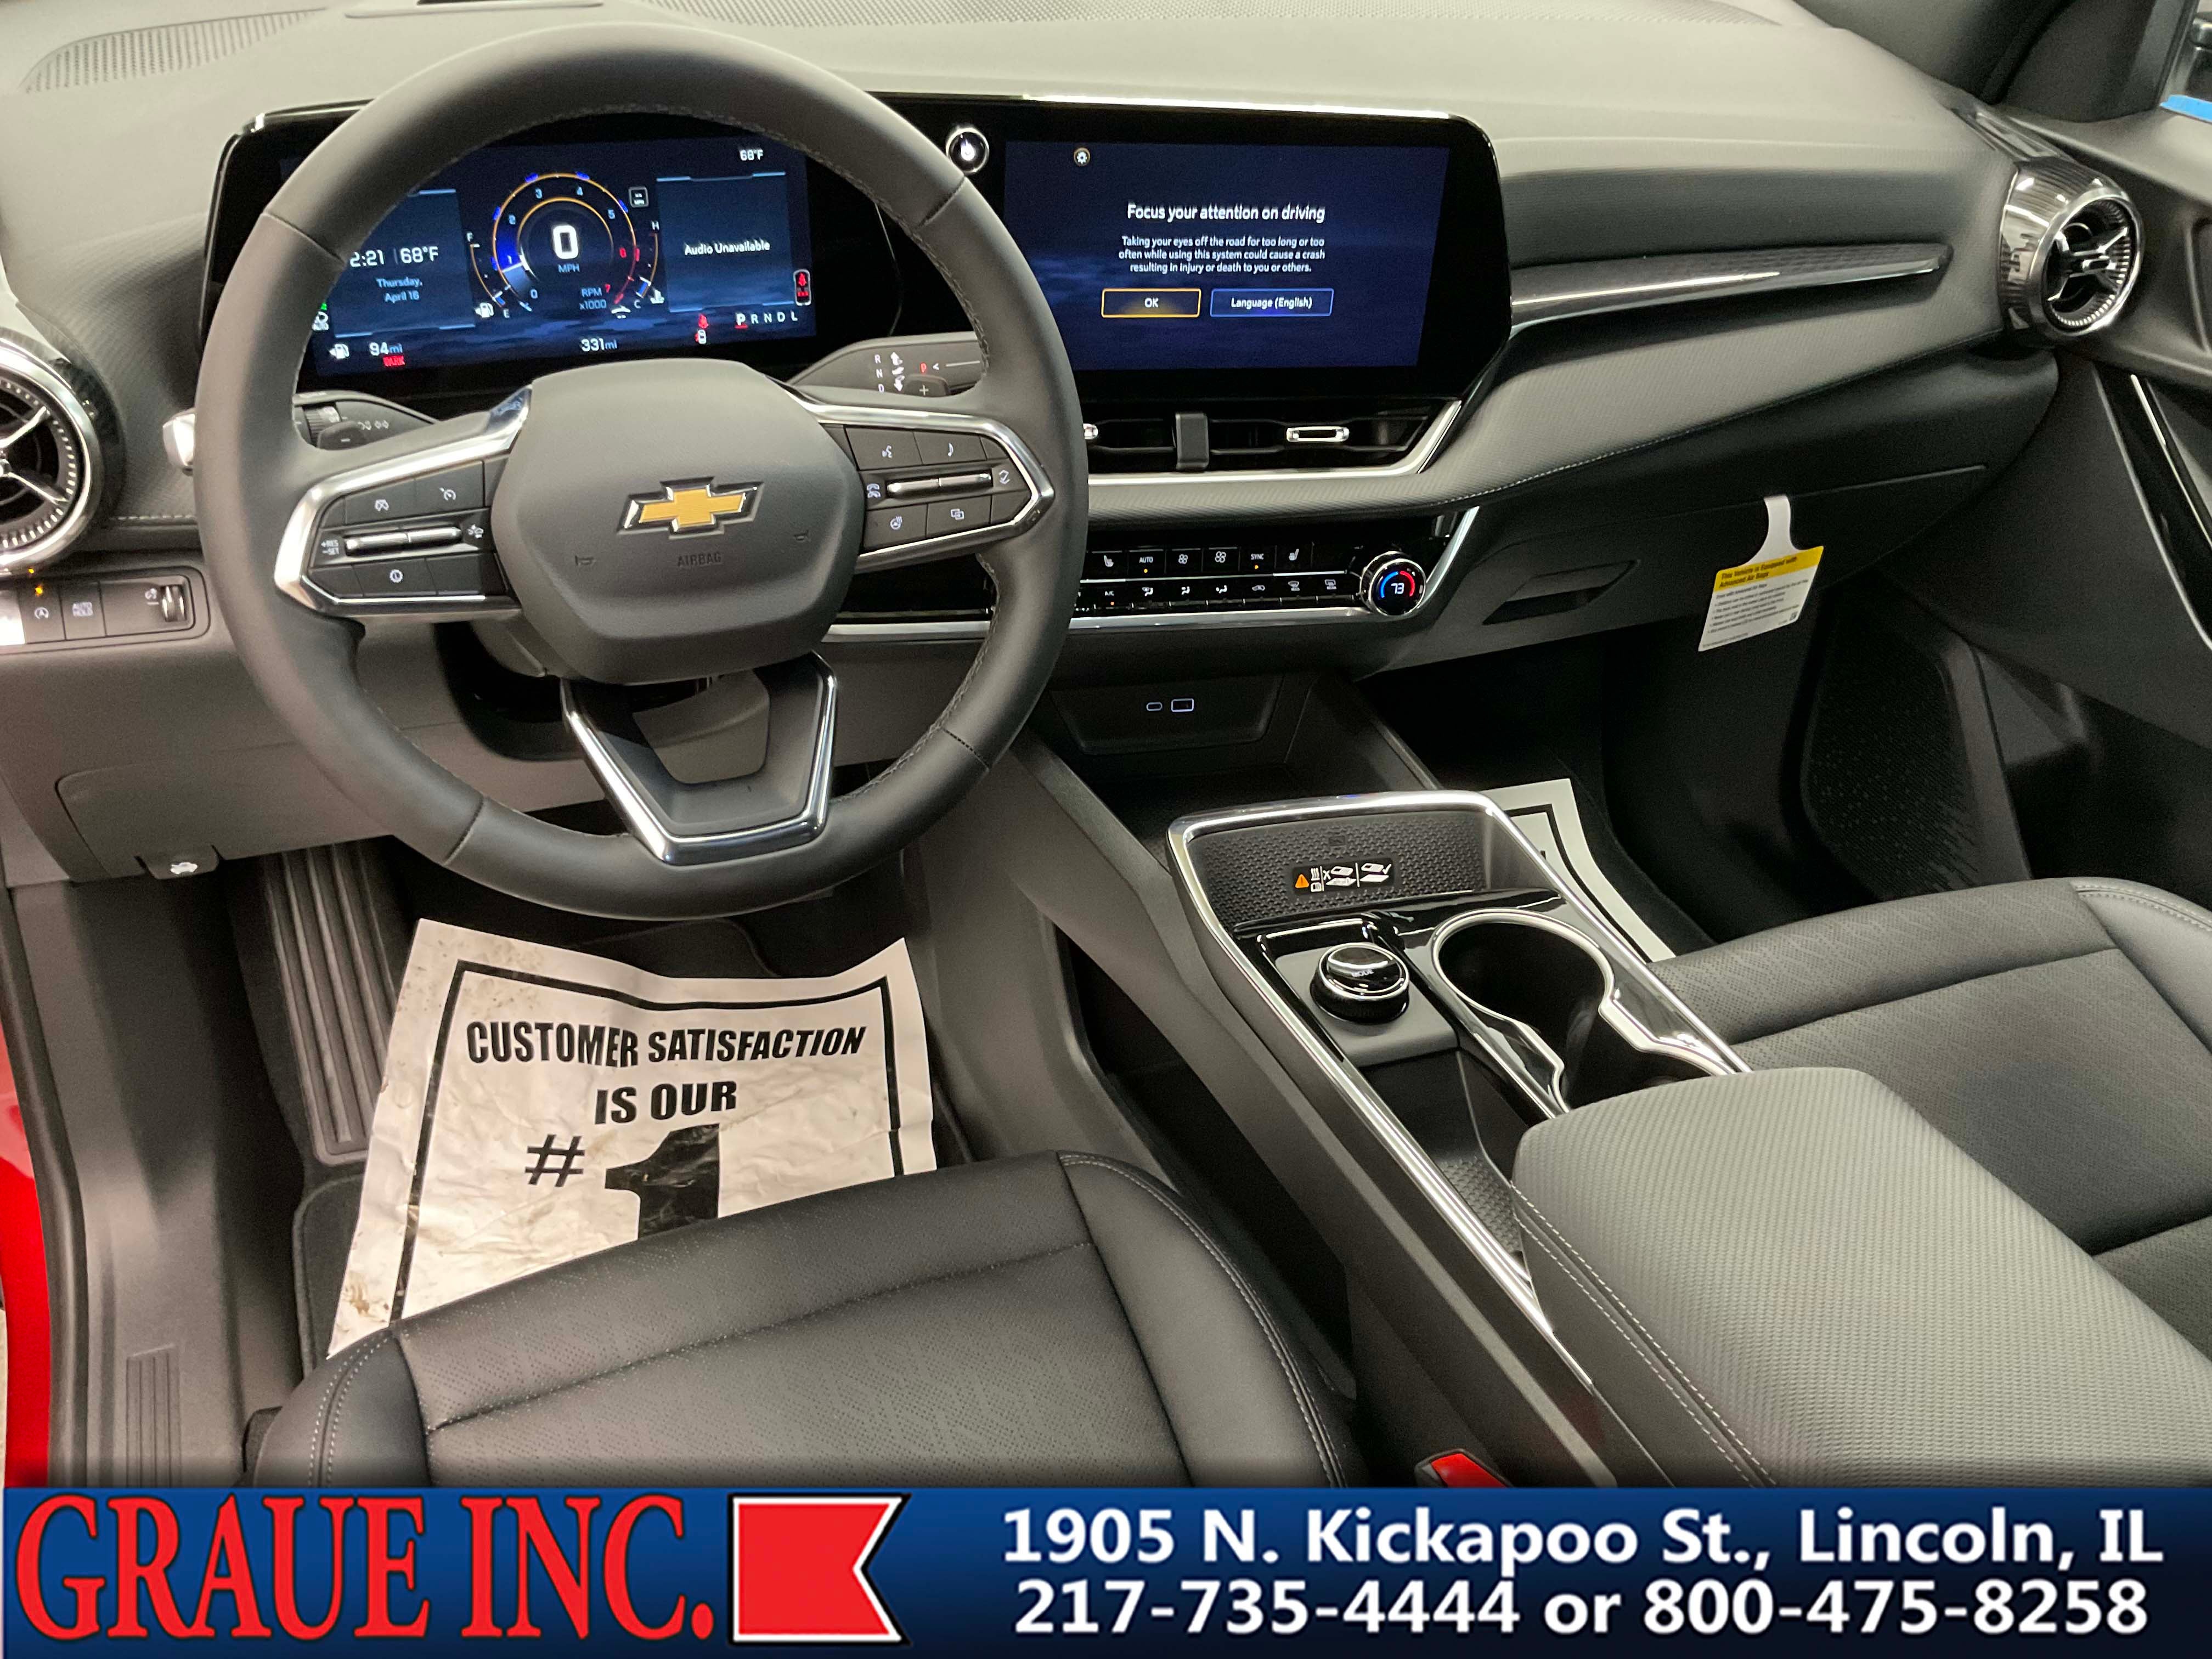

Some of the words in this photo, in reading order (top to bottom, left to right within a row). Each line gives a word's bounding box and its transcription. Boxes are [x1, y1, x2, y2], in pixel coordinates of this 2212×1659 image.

[740, 148, 764, 161] 68°F
[535, 188, 543, 199] 3
[577, 187, 584, 196] 4
[608, 209, 616, 219] 5
[1128, 203, 1166, 219] Focus
[1167, 206, 1198, 223] your
[1200, 204, 1259, 219] attention
[1262, 207, 1278, 219] on
[1282, 203, 1325, 224] driving
[651, 221, 660, 230] H
[552, 225, 579, 259] 0
[685, 242, 713, 256] Audio
[715, 238, 770, 255] Unavailable
[1121, 235, 1150, 249] Taking
[1152, 238, 1172, 248] your
[1173, 239, 1193, 249] eyes
[1195, 235, 1209, 246] off
[1210, 235, 1224, 246] the
[1226, 235, 1245, 246] road
[1248, 235, 1260, 246] for
[1262, 237, 1277, 246] too
[1278, 235, 1297, 249] long
[1299, 238, 1308, 246] or
[1310, 237, 1325, 246] too
[400, 246, 438, 264] 68°F
[1118, 249, 1143, 259] often
[1144, 249, 1167, 259] while
[1169, 250, 1192, 262] using
[1194, 249, 1210, 259] this
[1212, 250, 1242, 262] system
[1244, 249, 1268, 259] could
[1269, 251, 1294, 259] cause
[1295, 251, 1301, 259] a
[1302, 249, 1325, 259] crash
[557, 264, 580, 273] MPH
[1130, 262, 1168, 274] resulting
[1170, 262, 1178, 272] in
[1180, 262, 1204, 274] injury
[1205, 264, 1215, 272] or
[1216, 262, 1242, 272] death
[1243, 262, 1252, 272] to
[1254, 264, 1269, 274] you
[1271, 264, 1281, 272] or
[1282, 262, 1312, 272] others.
[385, 291, 407, 303] April
[582, 287, 602, 297] RPM
[579, 299, 607, 311] x1000
[1144, 298, 1159, 308] OK
[1231, 297, 1273, 309] Language
[1274, 297, 1312, 309] (English)
[736, 313, 747, 325] P
[750, 314, 759, 325] R
[764, 313, 772, 323] N
[777, 311, 786, 322] D
[791, 311, 799, 321] L
[873, 354, 882, 364] R
[876, 368, 883, 379] N
[919, 362, 927, 374] P
[878, 383, 885, 393] D
[677, 552, 722, 567] AIRBAG
[1391, 583, 1404, 595] 73
[467, 1021, 639, 1068] CUSTOMER
[648, 1026, 867, 1063] SATISFACTION
[595, 1086, 637, 1125] IS
[651, 1080, 737, 1120] OUR
